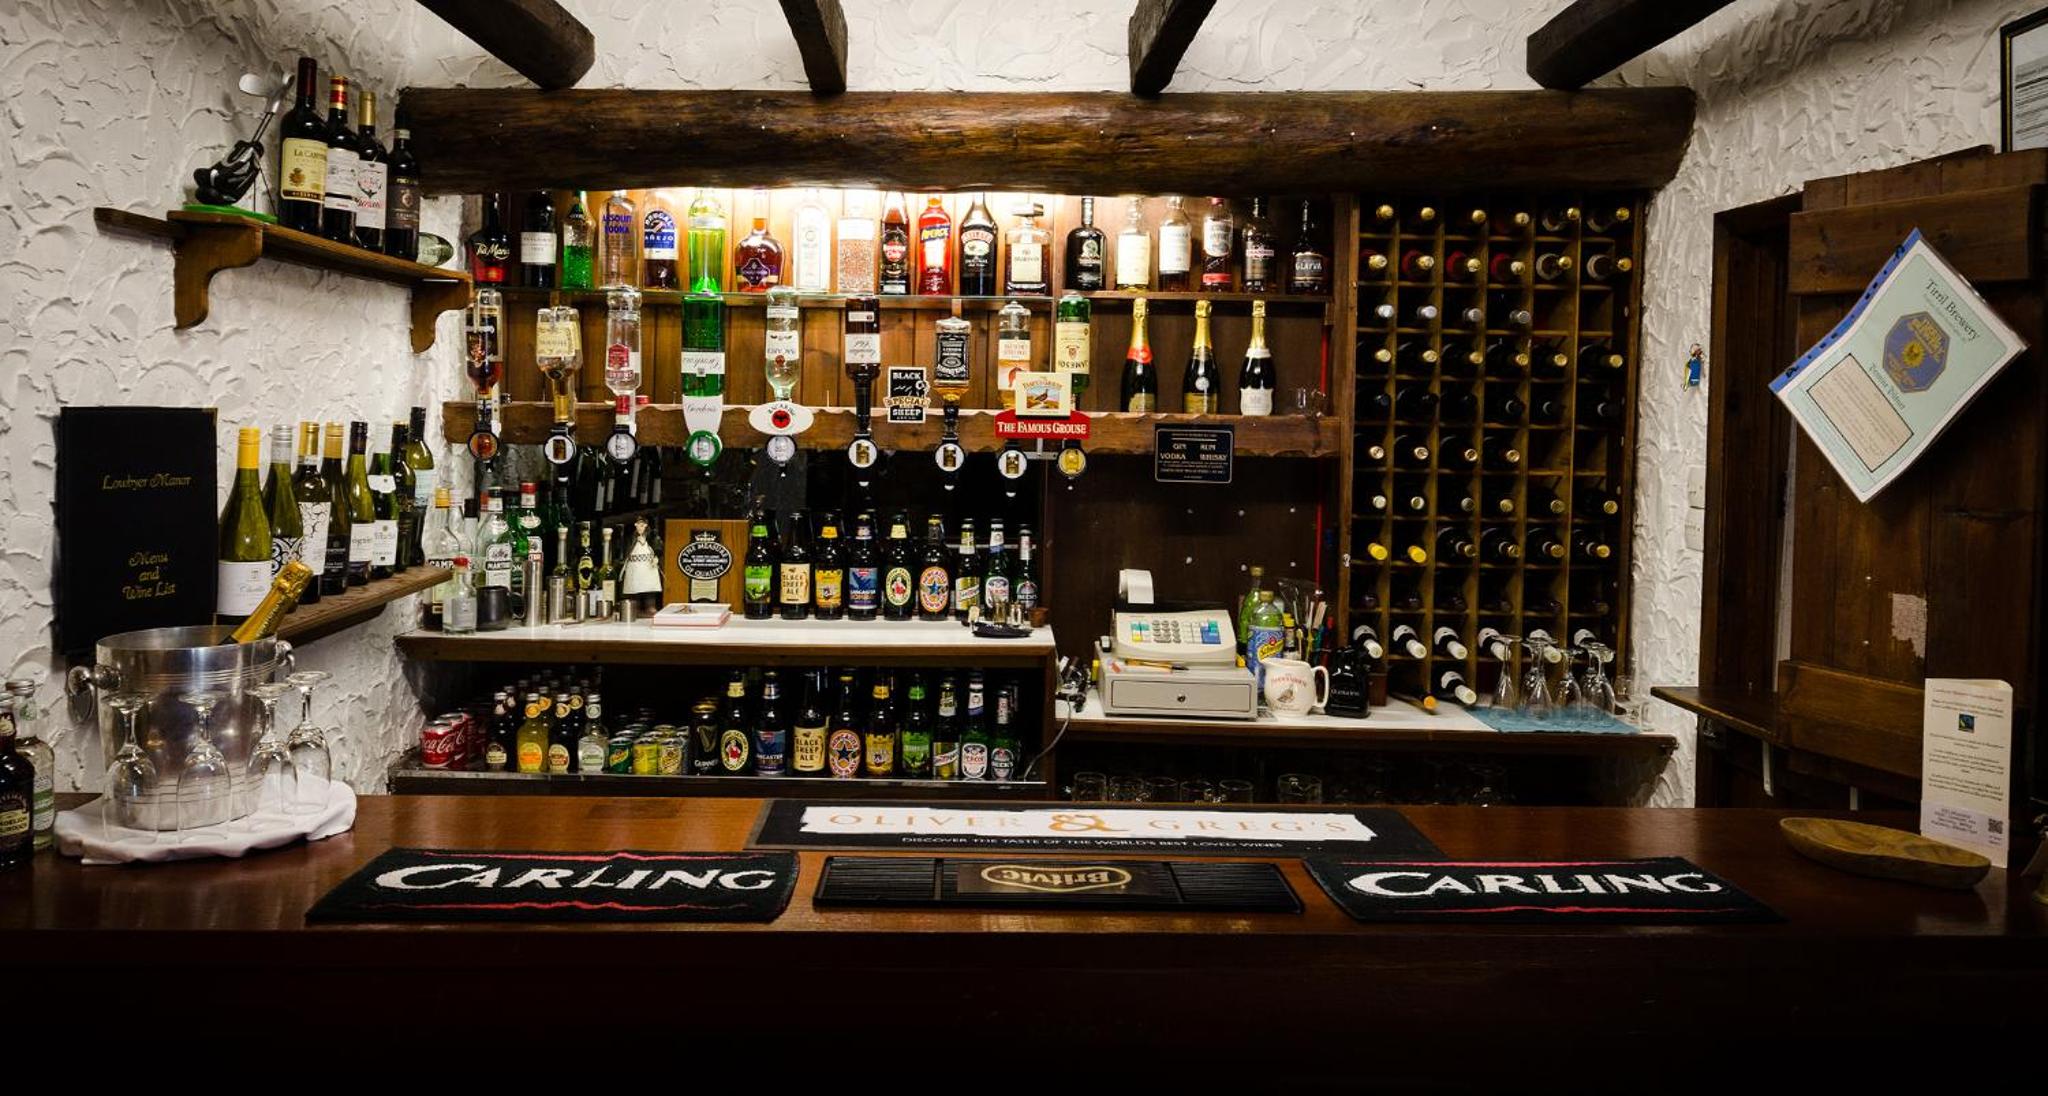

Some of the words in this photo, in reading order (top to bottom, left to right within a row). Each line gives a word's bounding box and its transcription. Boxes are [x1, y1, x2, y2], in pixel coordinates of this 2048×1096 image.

[1944, 301, 1981, 342] Brewery
[892, 372, 922, 381] BLACK
[892, 408, 922, 416] SHEEP
[996, 421, 1016, 433] THE
[1017, 421, 1052, 435] FAMOUS
[1052, 422, 1087, 435] GROUSE
[697, 543, 729, 558] MEASURE
[138, 565, 161, 581] and
[684, 565, 694, 574] OF
[694, 565, 724, 577] QUALITY
[154, 580, 177, 597] List
[828, 814, 1026, 828] OLIVER
[1048, 813, 1129, 832] &
[1148, 819, 1347, 834] GREG'S
[374, 864, 775, 890] CARLING
[1001, 869, 1111, 886] Britvic
[1345, 871, 1722, 897] CARLING
